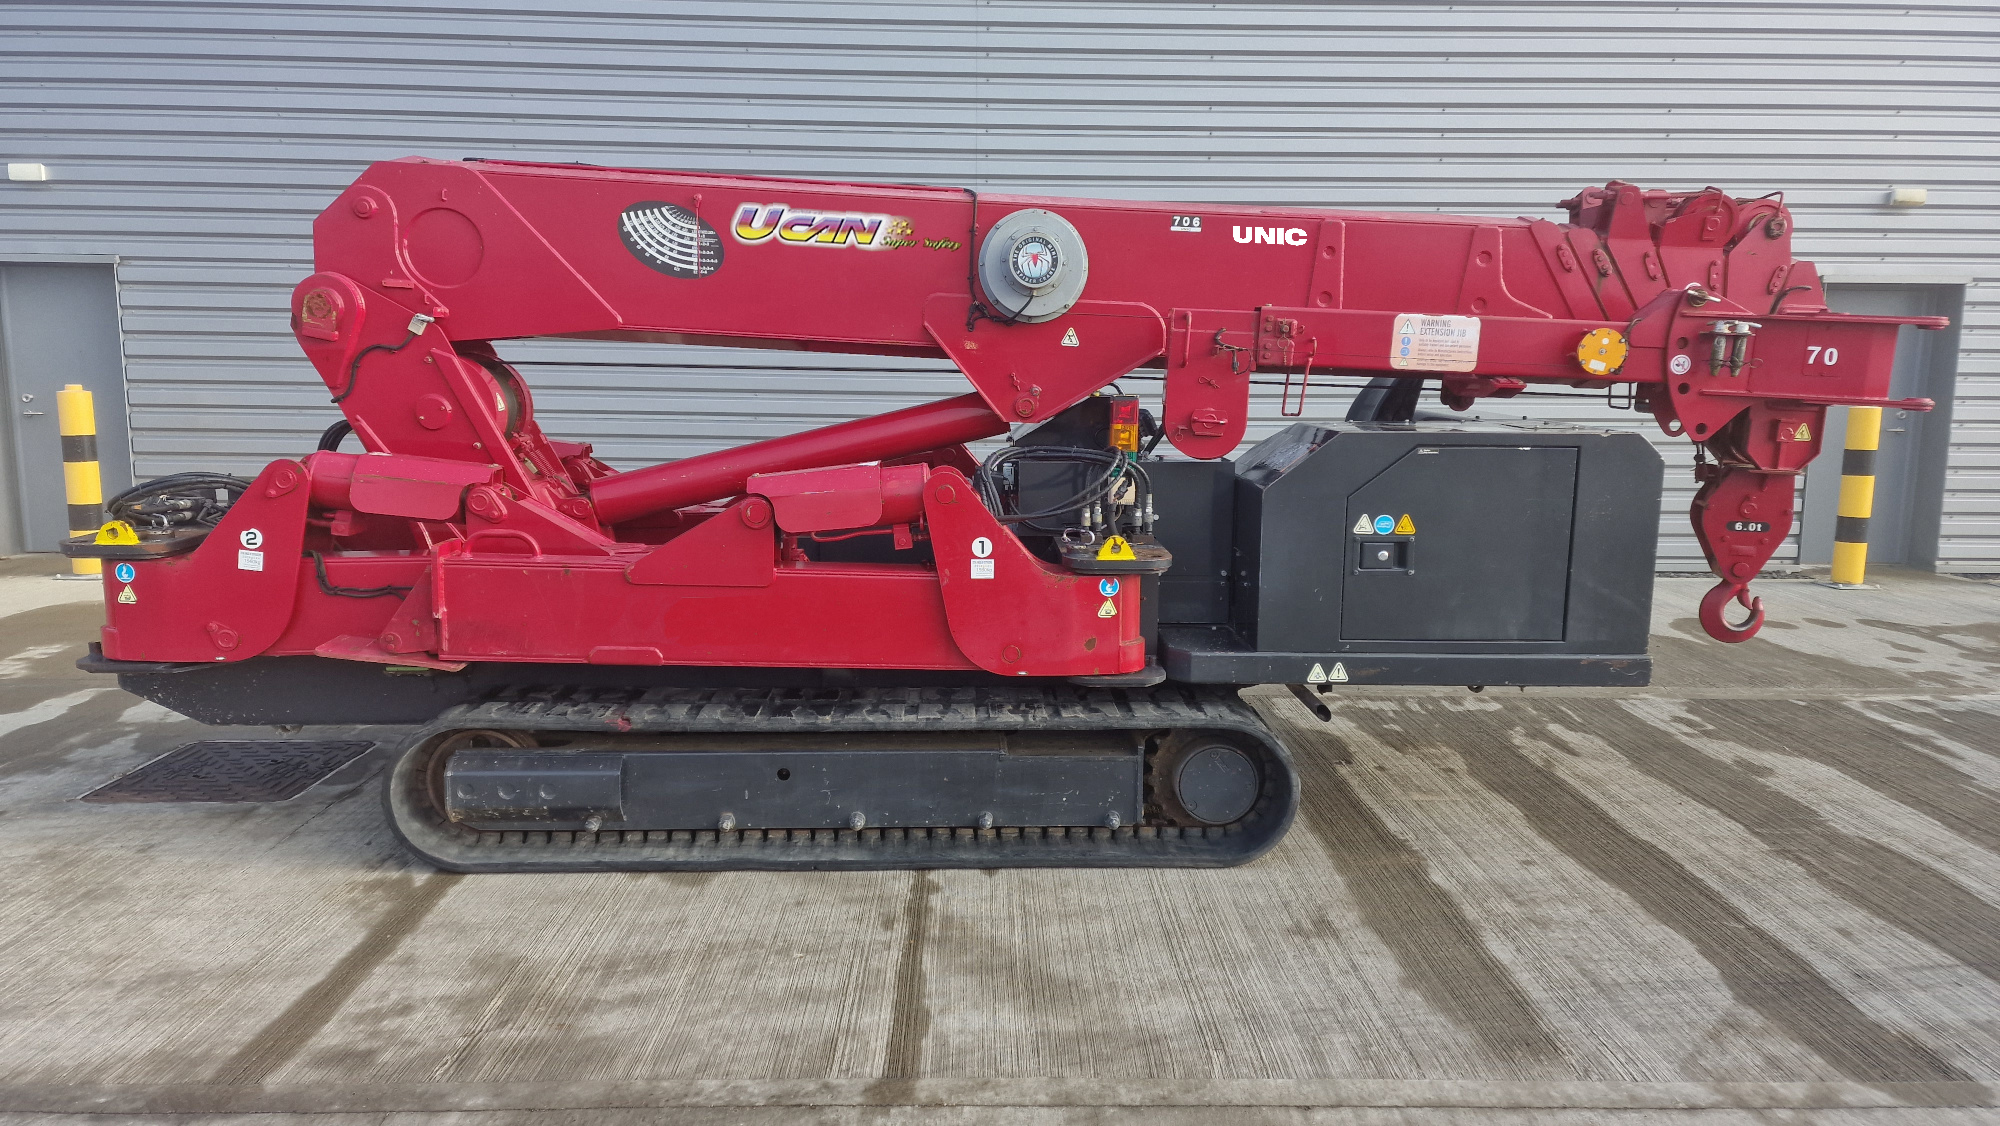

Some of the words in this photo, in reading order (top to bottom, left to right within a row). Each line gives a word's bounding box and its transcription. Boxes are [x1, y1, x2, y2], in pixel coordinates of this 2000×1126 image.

[734, 205, 883, 246] UCAN
[1173, 216, 1201, 227] 706
[880, 235, 918, 250] Super
[1232, 225, 1308, 247] UNIC
[1012, 249, 1020, 261] THE
[1018, 236, 1047, 249] ORIGINAL
[1047, 243, 1057, 259] MINI
[1015, 269, 1037, 284] SPIDER
[1039, 267, 1056, 283] CRANE
[1420, 319, 1452, 328] WARNING
[1420, 327, 1456, 336] EXTENSION
[1456, 329, 1467, 337] JIB
[1807, 345, 1839, 366] 70
[1734, 522, 1762, 531] 6.0t
[245, 531, 257, 545] 2
[978, 540, 985, 554] 1
